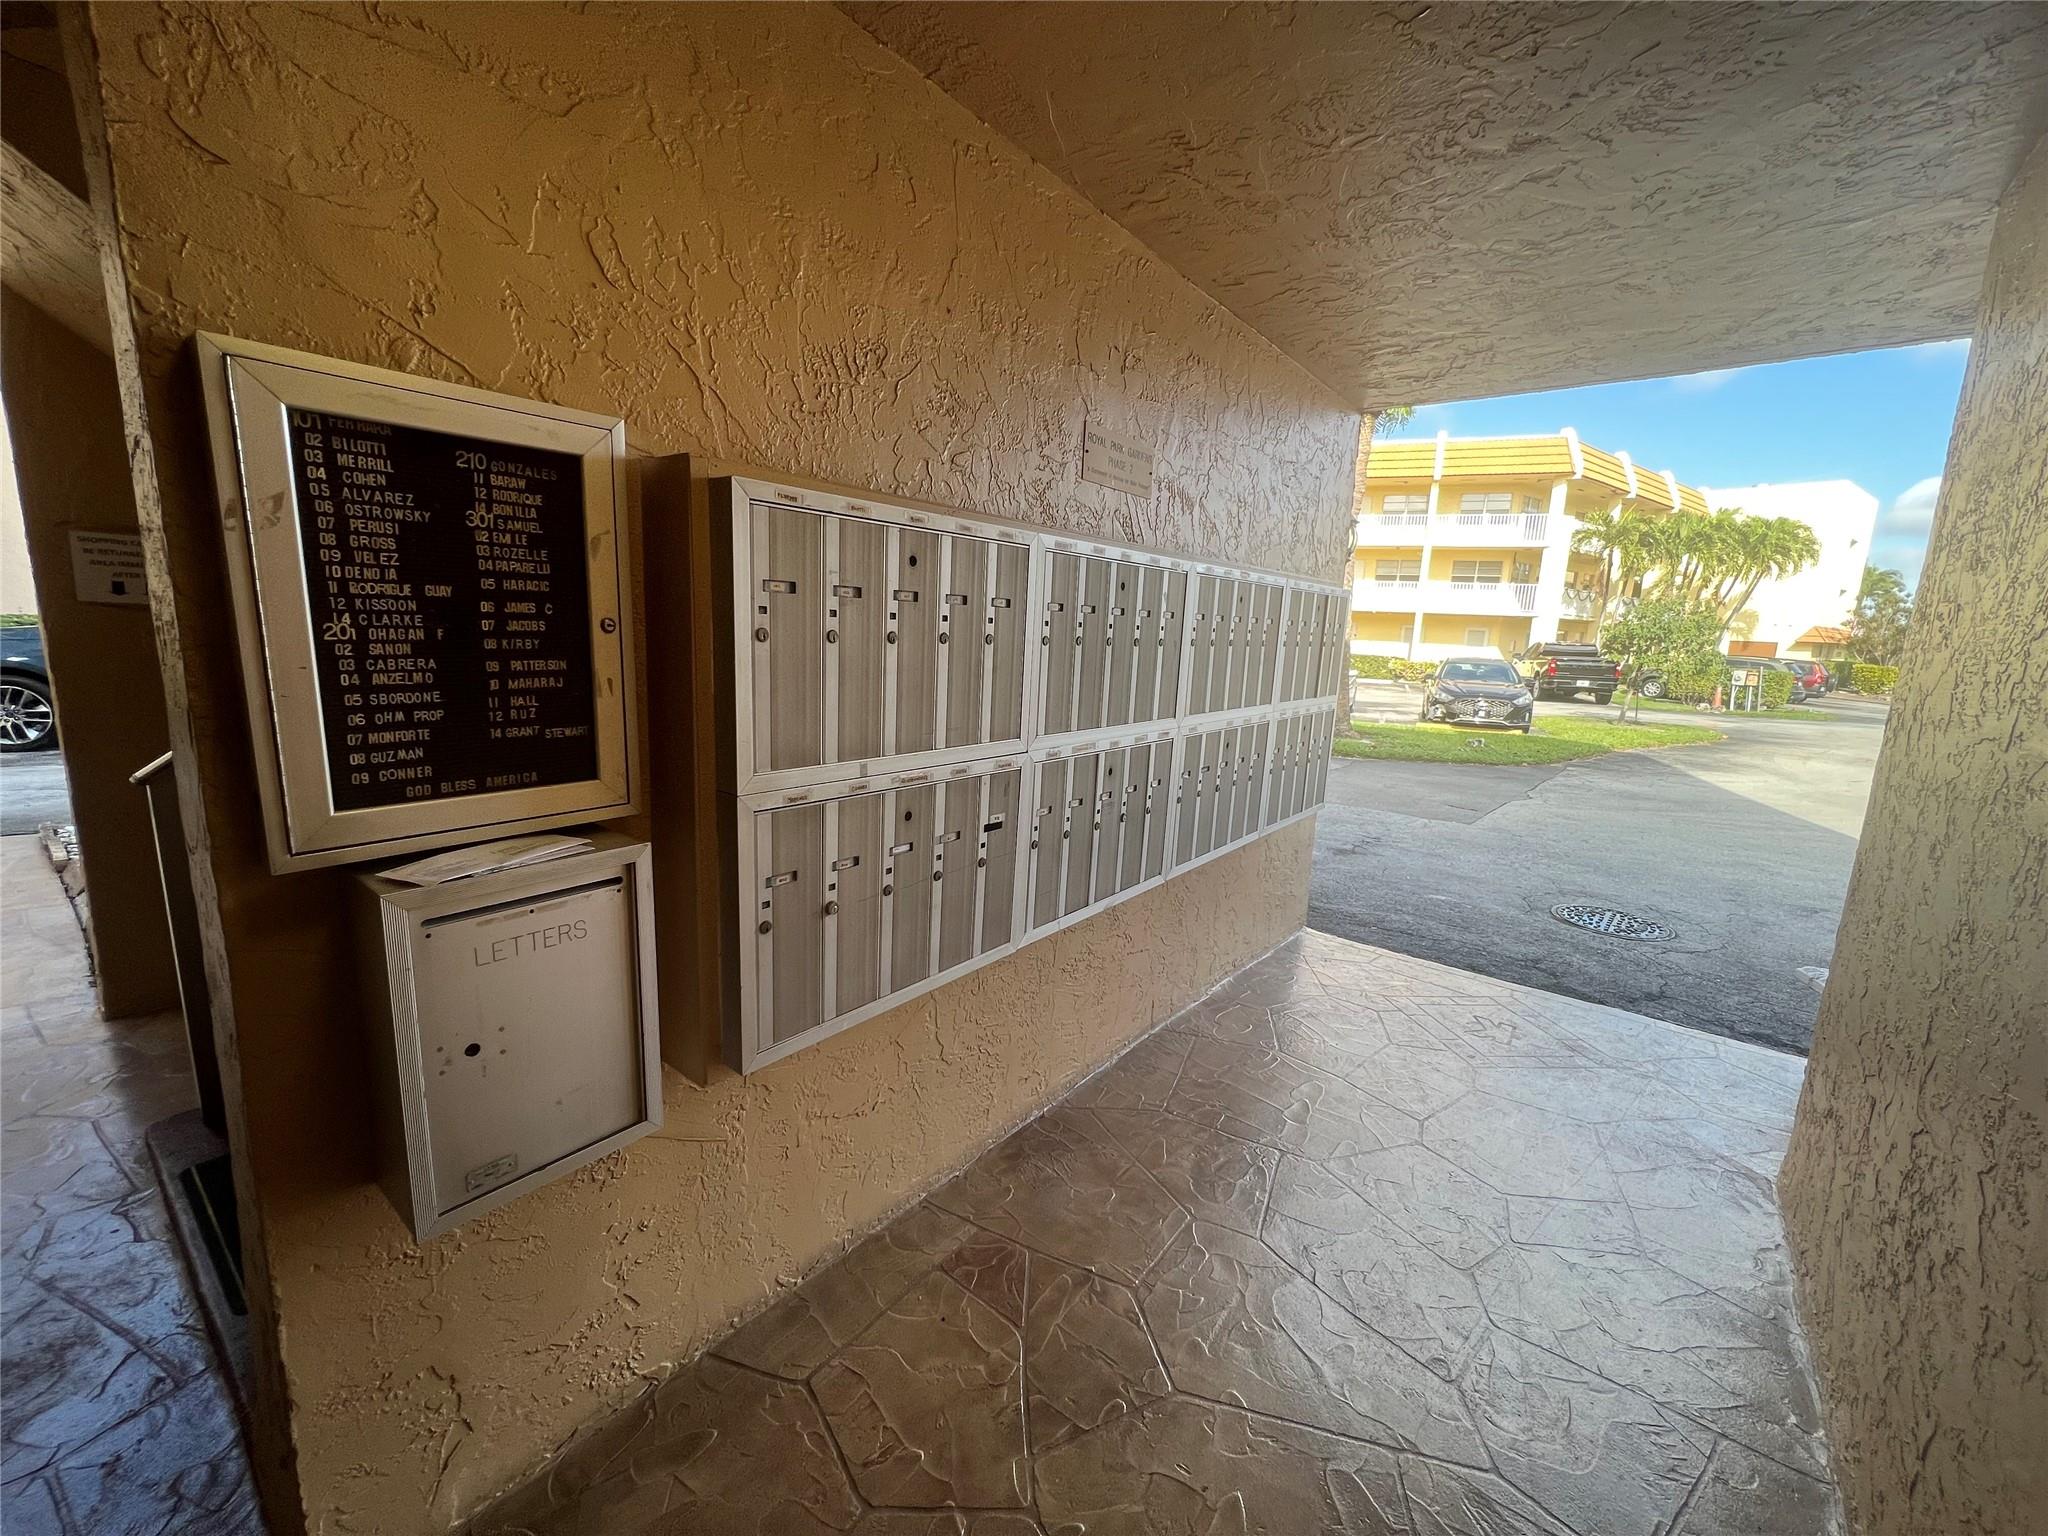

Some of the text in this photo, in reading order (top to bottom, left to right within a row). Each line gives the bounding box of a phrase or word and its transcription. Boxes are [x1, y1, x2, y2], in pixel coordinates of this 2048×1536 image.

[305, 433, 387, 456] 02 BILOTTI
[1087, 432, 1107, 448] ROYAL
[304, 449, 395, 473] 03 MERRILL
[455, 450, 558, 481] 210 GONZALES
[307, 466, 386, 487] 04 COHEN
[473, 471, 484, 484] 11
[309, 483, 415, 506] 05 ALVAREZ
[474, 486, 487, 499] 12
[315, 500, 431, 523] 06 OSTROWSKY
[475, 501, 537, 519] 14 BONILLA
[317, 516, 399, 535] 07 PERUSI
[465, 510, 543, 534] 301 SAMUEL
[320, 532, 396, 549] 08 GROSS
[475, 530, 490, 542] 02
[320, 549, 400, 566] 09 VELEZ
[476, 545, 549, 560] 03 ROZELLE
[325, 565, 341, 578] 10
[478, 559, 493, 571] 04
[328, 581, 338, 594] 11
[424, 584, 452, 597] GUAY
[480, 578, 496, 590] 05
[329, 597, 417, 611] 12 KISSOON
[480, 601, 553, 615] 06 JAMES C
[333, 612, 423, 626] 14 CLARKE
[481, 620, 546, 632] 07 JACOBS
[322, 623, 445, 641] 201 OHAGAN F
[335, 643, 412, 656] 02 SANON
[484, 638, 497, 649] 08
[338, 658, 437, 671] 03 CABRERA
[485, 660, 567, 672] 09 PATTERSON
[340, 672, 434, 686] 04 ANZELMO
[507, 677, 564, 690] MAHARAJ
[344, 691, 441, 706] 05 SBORDONE
[488, 695, 540, 709] 11 HALL
[347, 710, 445, 726] 06 OHM PROP
[488, 708, 537, 722] 12 RUZ
[347, 729, 430, 746] 07 MONFORTE
[490, 726, 589, 740] 14 GRANT STEWART
[349, 747, 424, 765] 08 GUZMAN
[351, 766, 432, 785] 09 CONNER
[406, 771, 538, 798] GOD BLESS AMERICA
[473, 919, 588, 967] LETTERS
